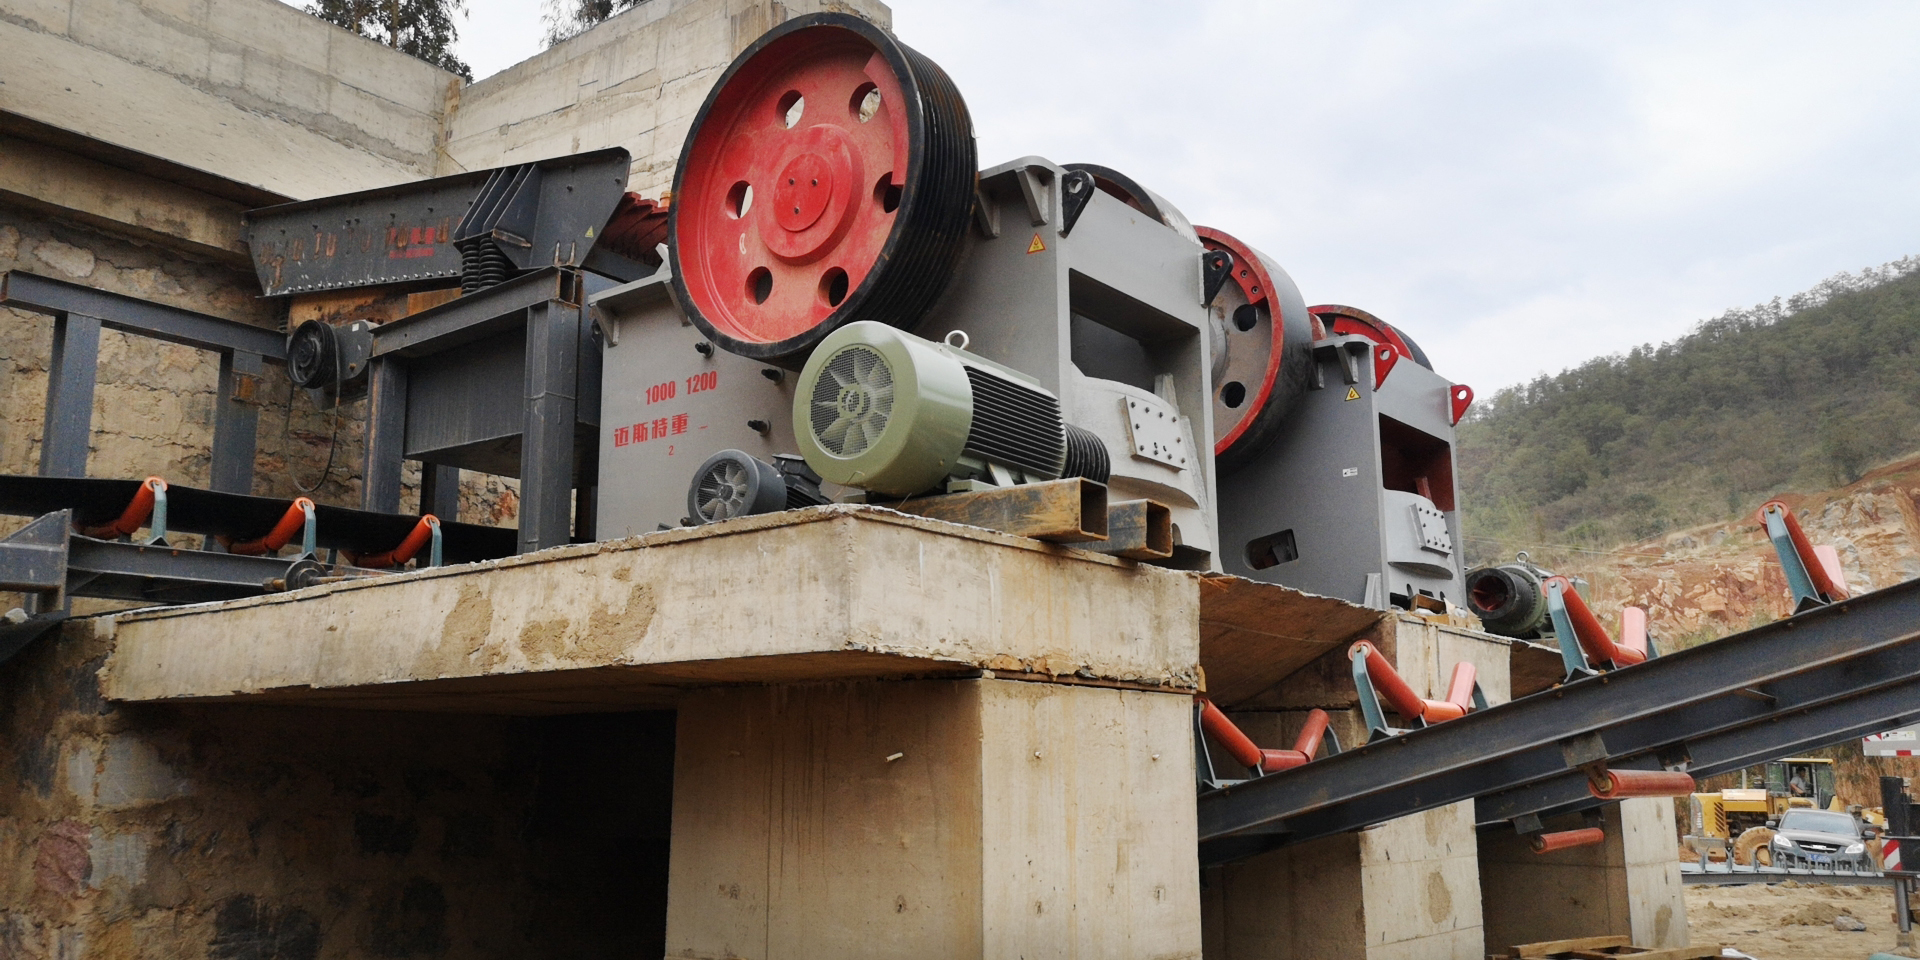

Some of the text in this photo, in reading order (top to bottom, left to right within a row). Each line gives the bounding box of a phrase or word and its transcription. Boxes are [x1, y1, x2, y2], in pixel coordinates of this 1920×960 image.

[645, 371, 717, 405] 1000 1200
[668, 445, 674, 456] 2
